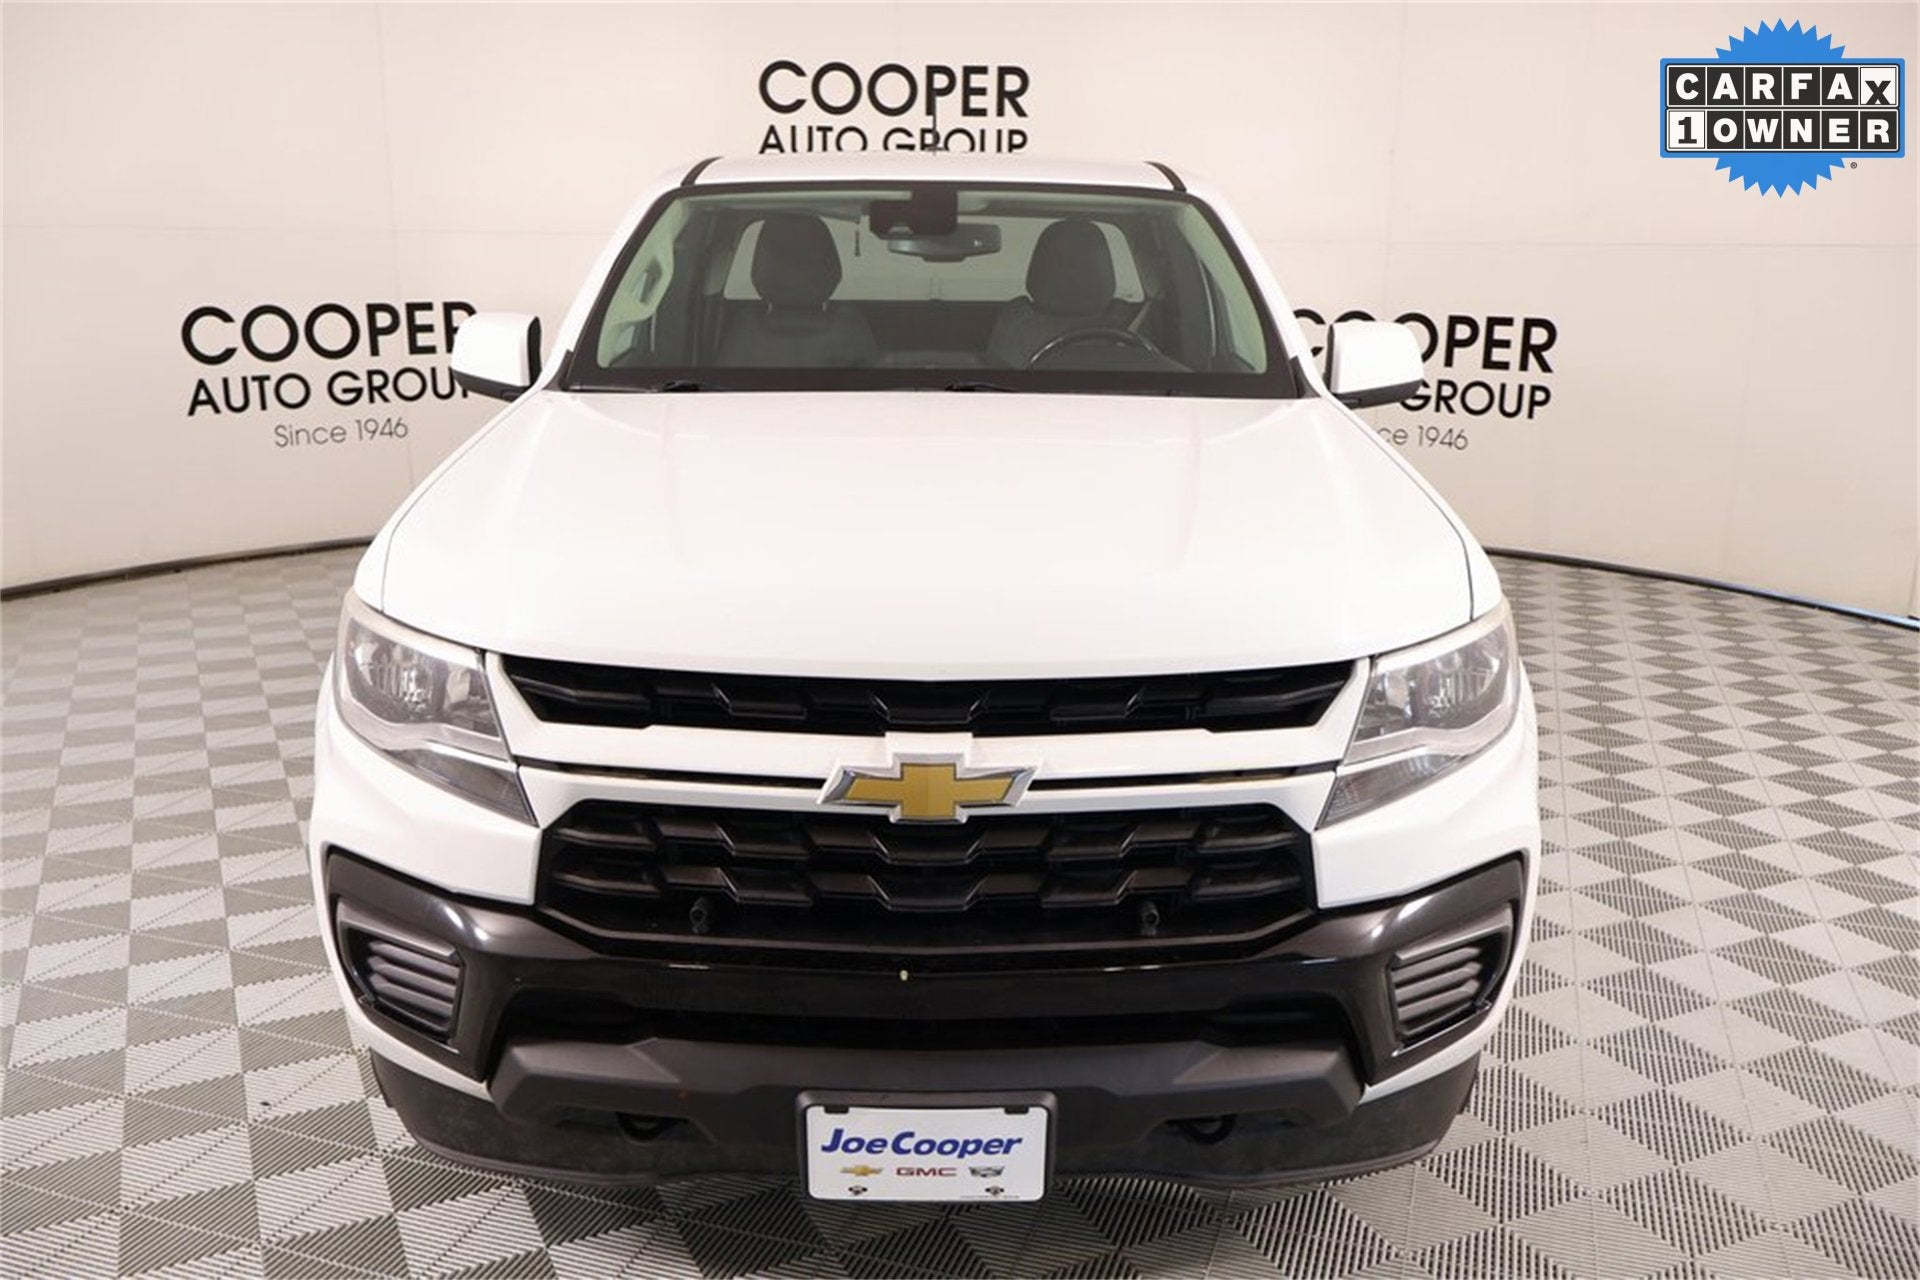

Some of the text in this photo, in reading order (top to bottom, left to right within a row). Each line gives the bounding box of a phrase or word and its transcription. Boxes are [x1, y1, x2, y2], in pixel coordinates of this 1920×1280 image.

[759, 60, 1029, 117] COOPER
[759, 124, 868, 154] AUTO
[187, 366, 468, 416] AUTO GROU
[274, 417, 408, 448] Since 1946
[1417, 425, 1468, 450] 1946
[896, 1167, 957, 1177] GMC
